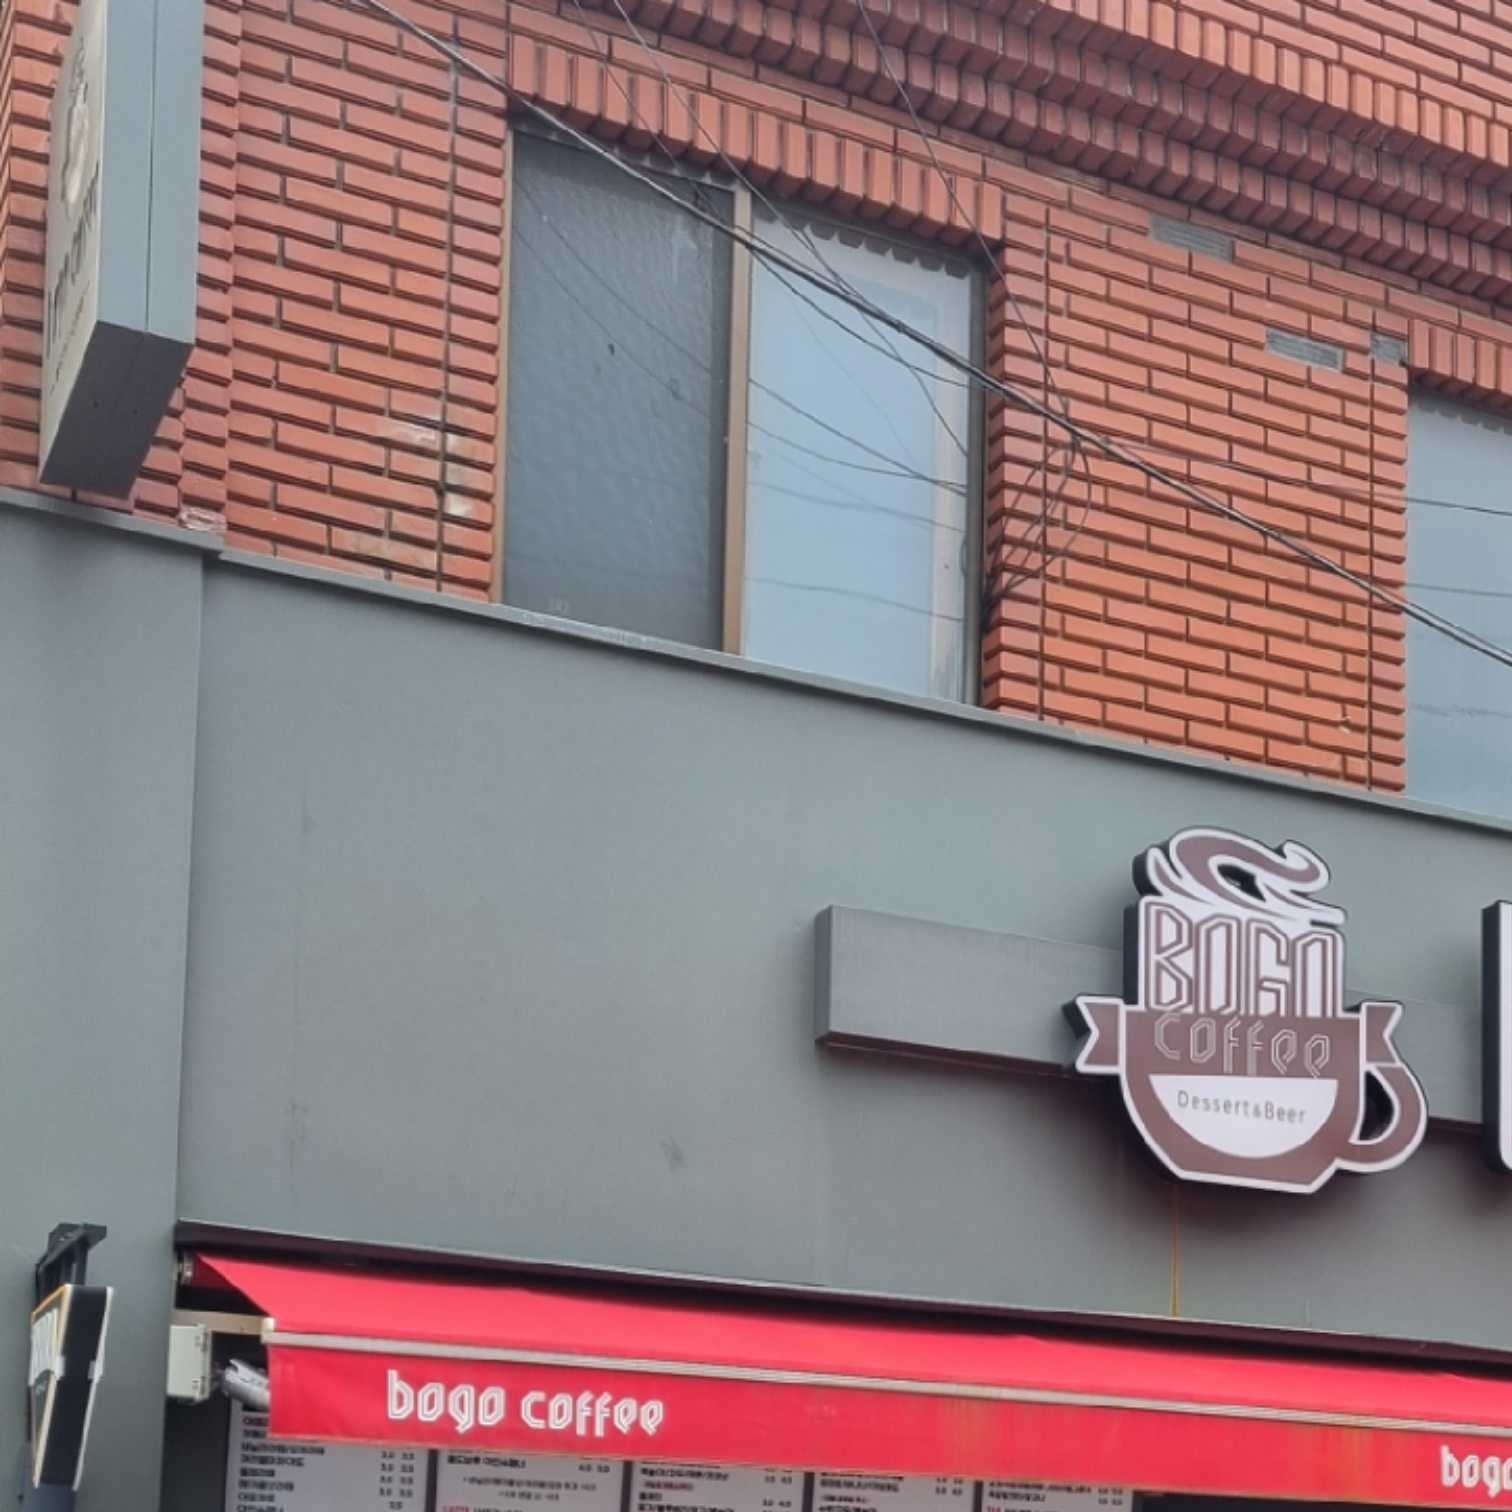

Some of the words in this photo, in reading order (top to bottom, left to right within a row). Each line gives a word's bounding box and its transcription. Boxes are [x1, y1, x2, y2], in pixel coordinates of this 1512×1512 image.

[1176, 1088, 1307, 1126] Dessert&Beer
[387, 1369, 506, 1434] bogo
[520, 1390, 664, 1437] coffee
